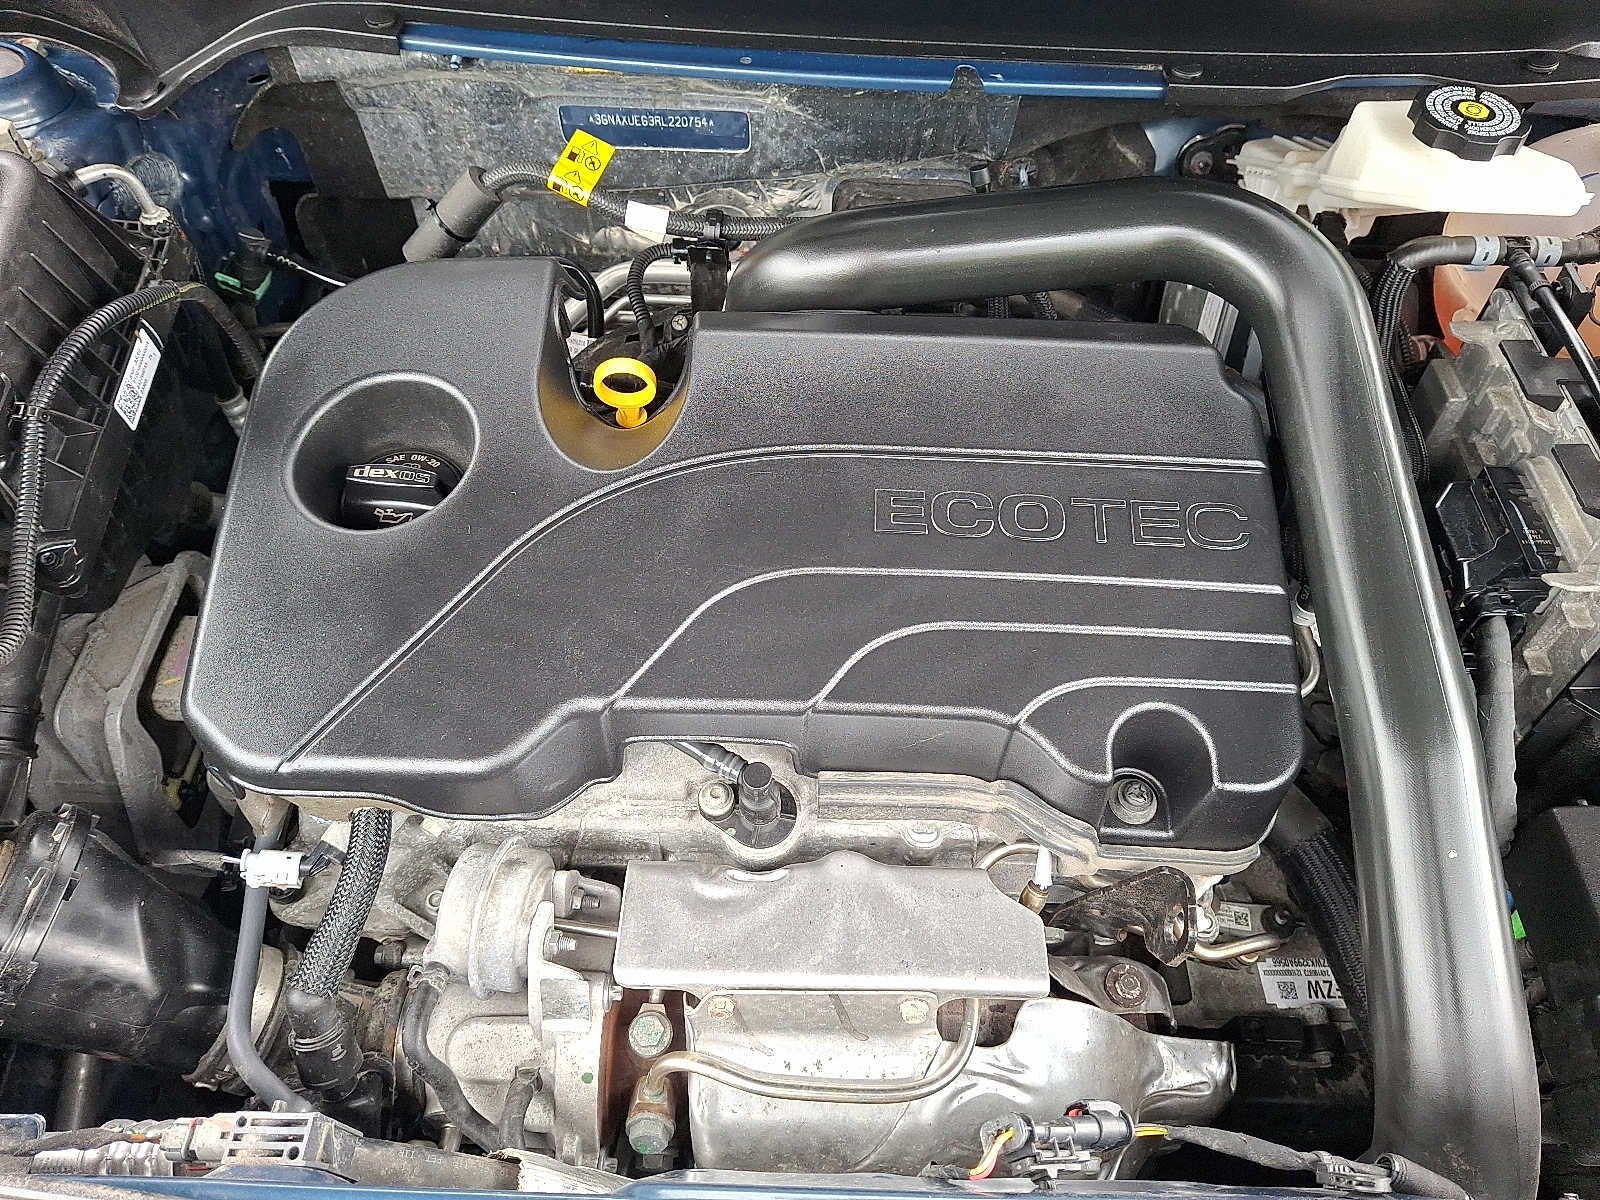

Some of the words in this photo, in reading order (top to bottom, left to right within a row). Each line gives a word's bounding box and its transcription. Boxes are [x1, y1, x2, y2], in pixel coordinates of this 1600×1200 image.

[386, 454, 406, 464] SAE
[410, 454, 441, 468] 0W-20
[353, 465, 431, 484] dexos
[874, 488, 1251, 551] ECOTEC
